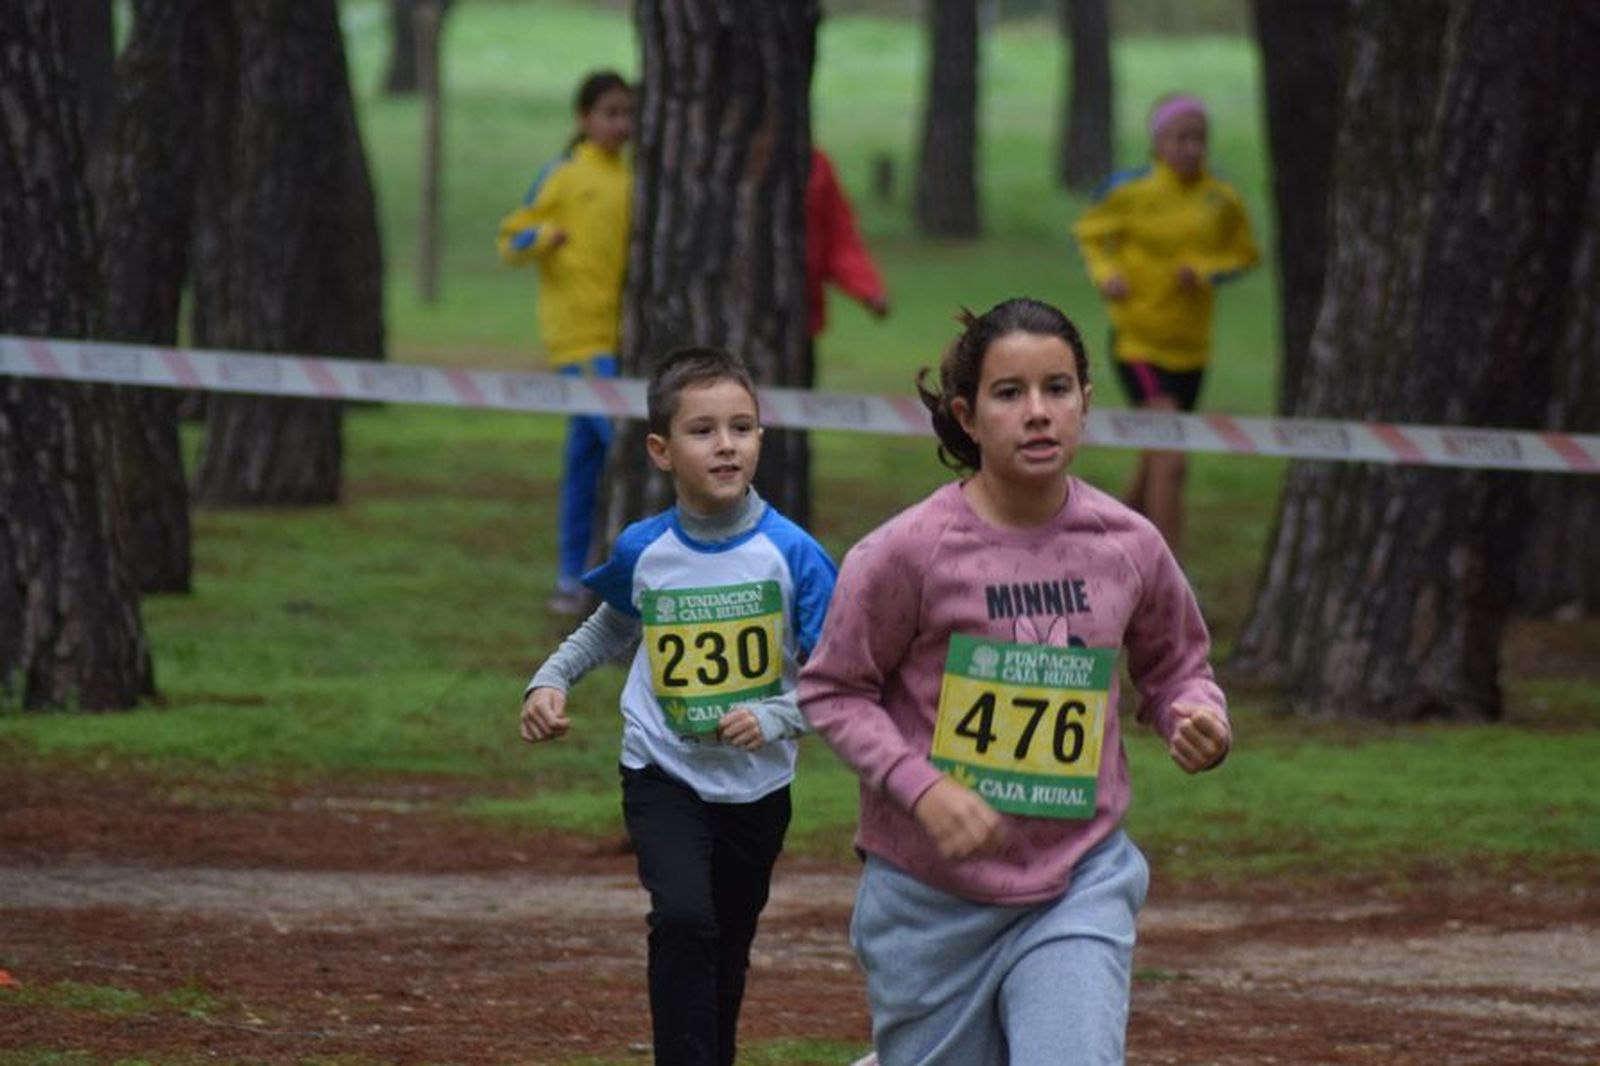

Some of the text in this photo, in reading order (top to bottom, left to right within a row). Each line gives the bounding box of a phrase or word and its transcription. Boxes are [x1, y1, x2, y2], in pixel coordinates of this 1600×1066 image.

[986, 579, 1089, 619] MINNIE
[679, 603, 763, 622] CAJA RURAL
[658, 626, 768, 687] 230
[1003, 669, 1091, 687] CAJA RURAL
[688, 704, 725, 721] CAJA
[955, 691, 1086, 763] 476
[980, 779, 1087, 805] CAJA RURAL
